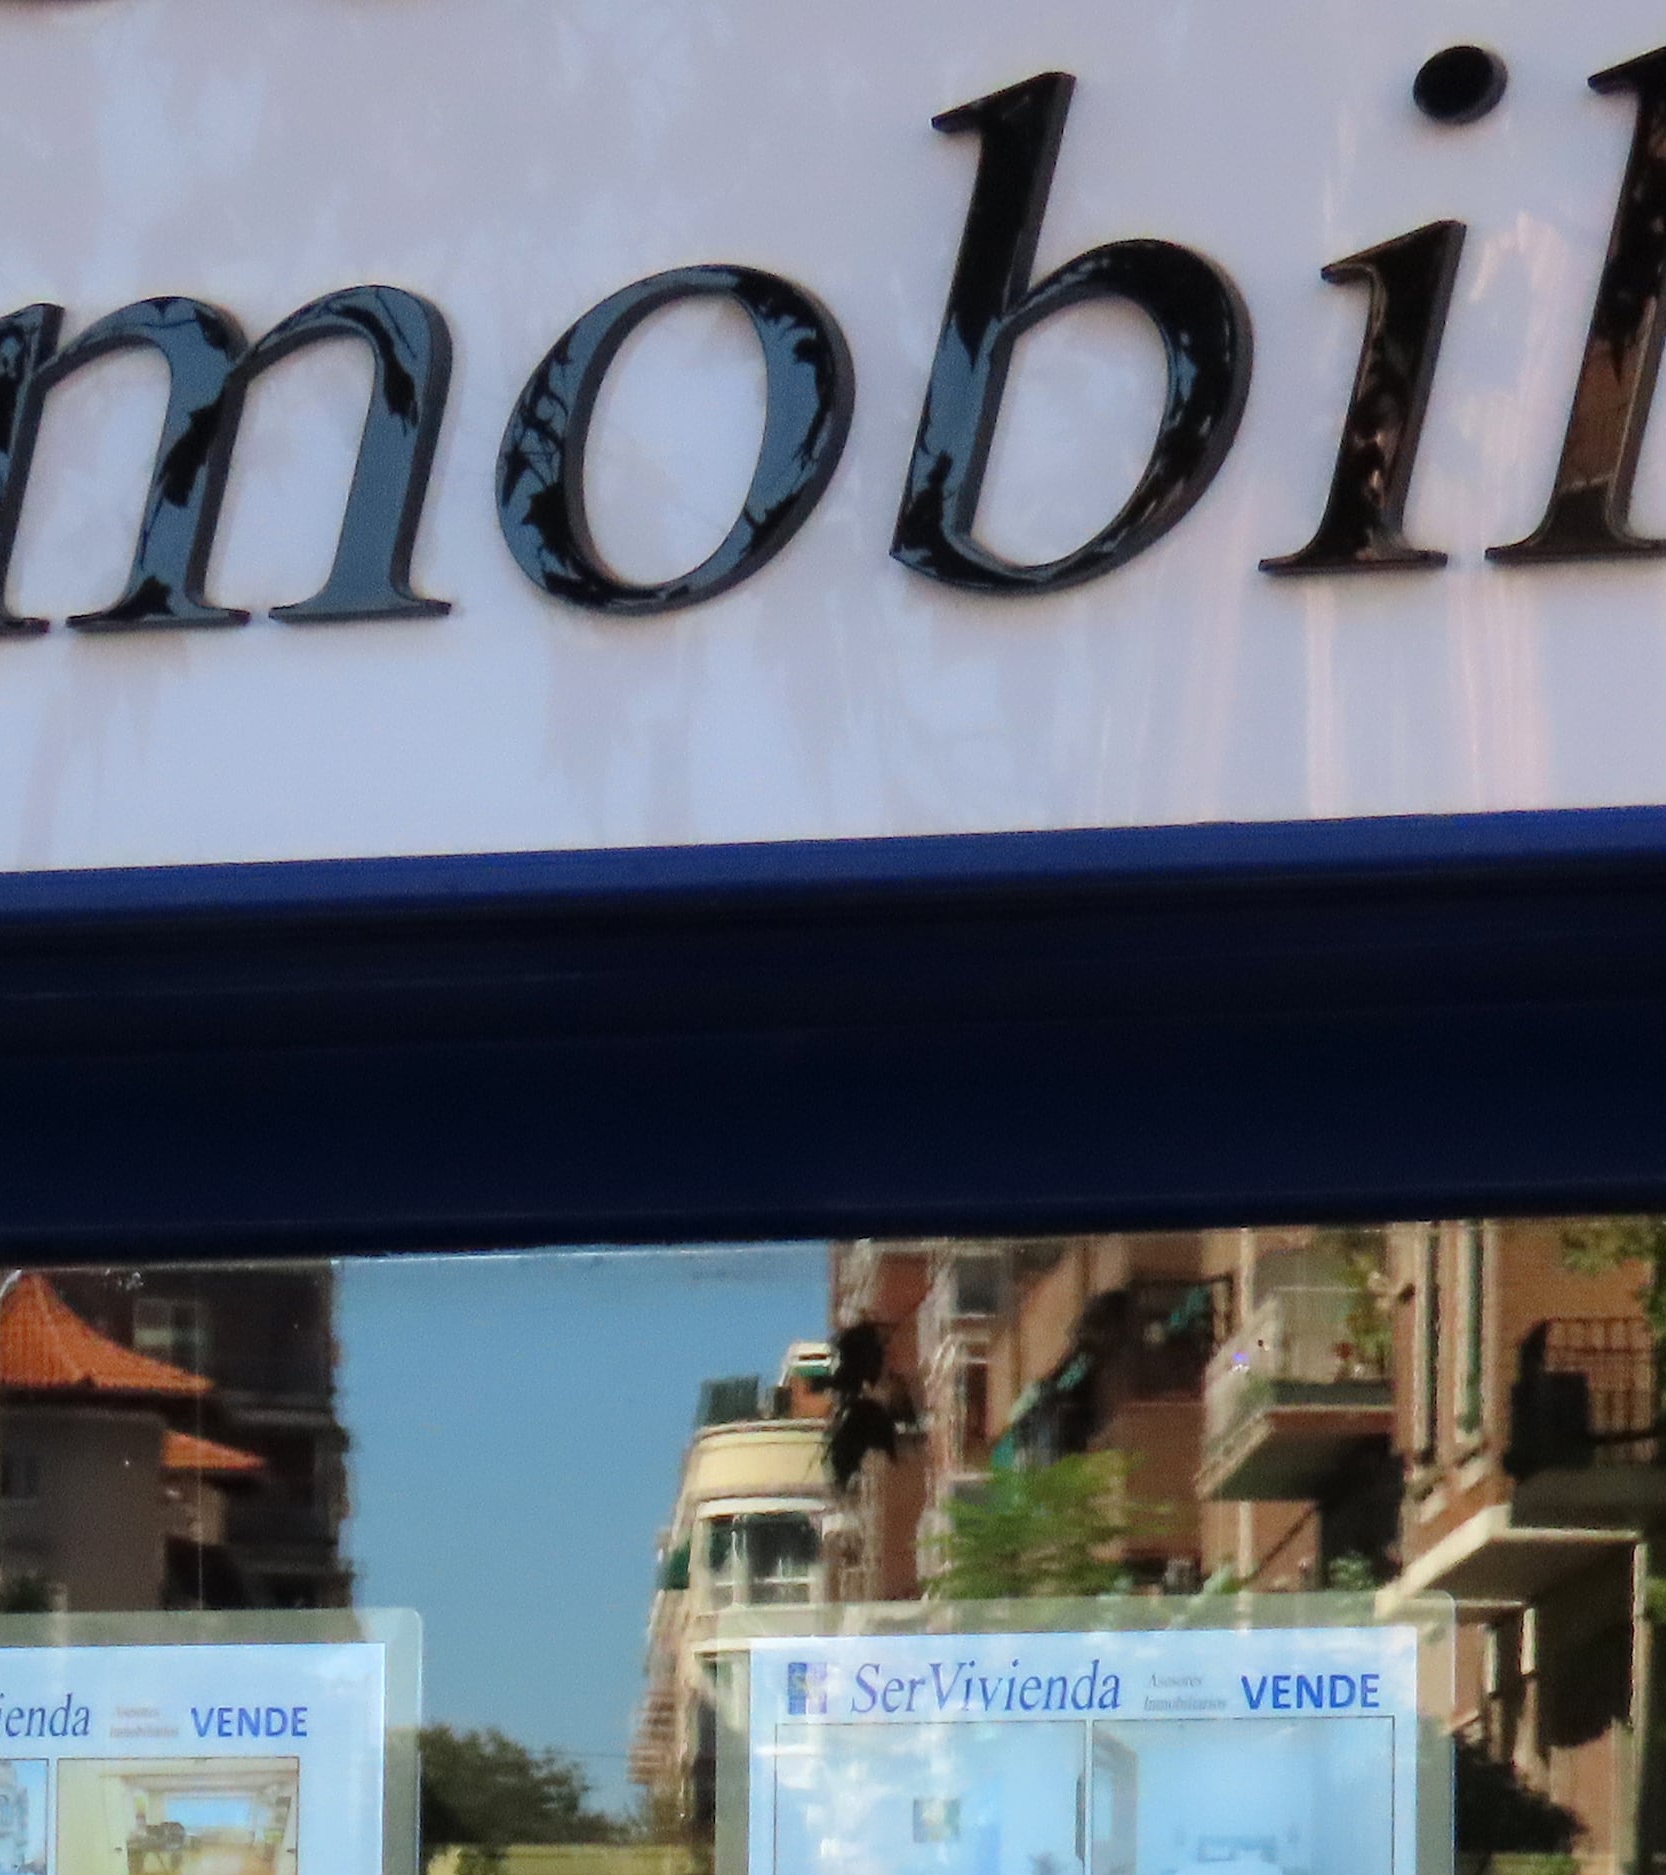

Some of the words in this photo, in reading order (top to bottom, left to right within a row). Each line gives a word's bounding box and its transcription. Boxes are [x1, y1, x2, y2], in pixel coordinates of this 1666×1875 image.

[850, 1658, 1123, 1714] SerVivienda
[1240, 1673, 1381, 1710] VENDE
[190, 1706, 309, 1739] VENDE
